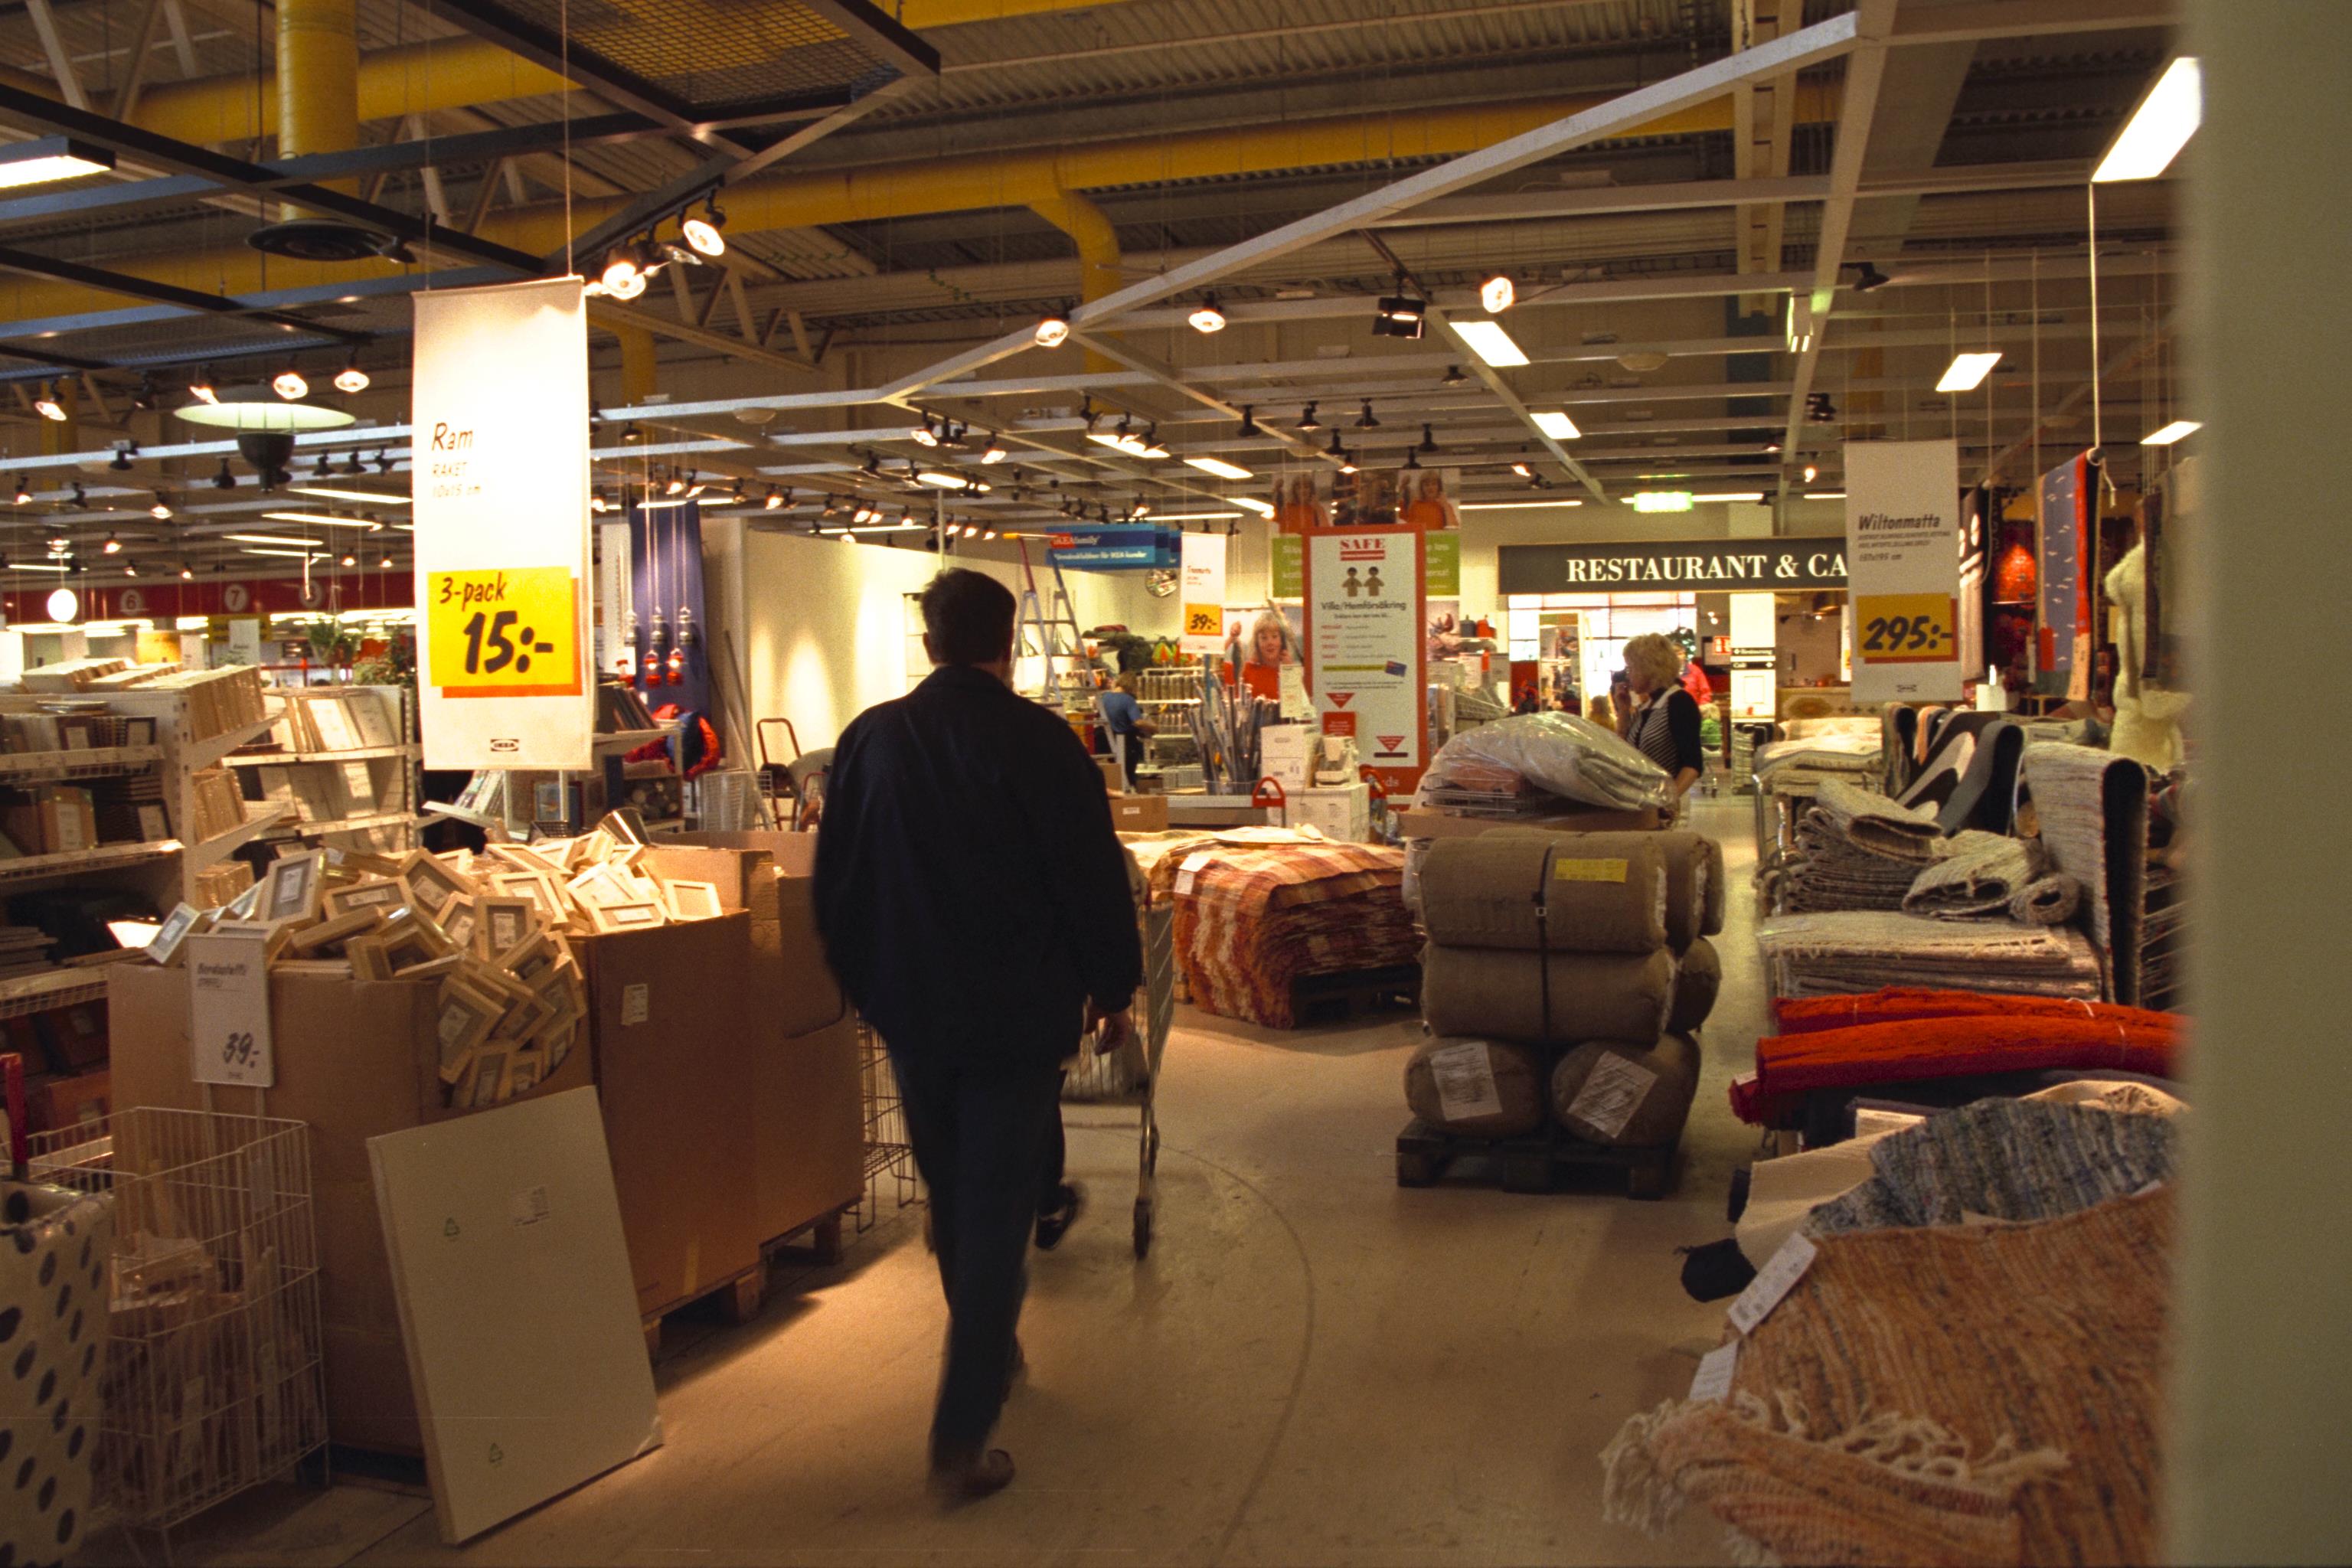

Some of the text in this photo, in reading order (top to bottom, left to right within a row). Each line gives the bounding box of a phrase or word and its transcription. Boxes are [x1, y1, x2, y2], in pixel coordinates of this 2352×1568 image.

[431, 422, 473, 451] Ram
[1858, 512, 1941, 531] Wiltonmatta
[1340, 538, 1386, 550] SAFE
[1566, 554, 1768, 583] RESTAURANT
[1774, 554, 1799, 578] &
[230, 590, 240, 606] 7
[439, 571, 507, 612] 3-pack
[1190, 613, 1217, 631] 39:-
[1863, 615, 1953, 651] 295:-
[462, 609, 555, 675] 15:-
